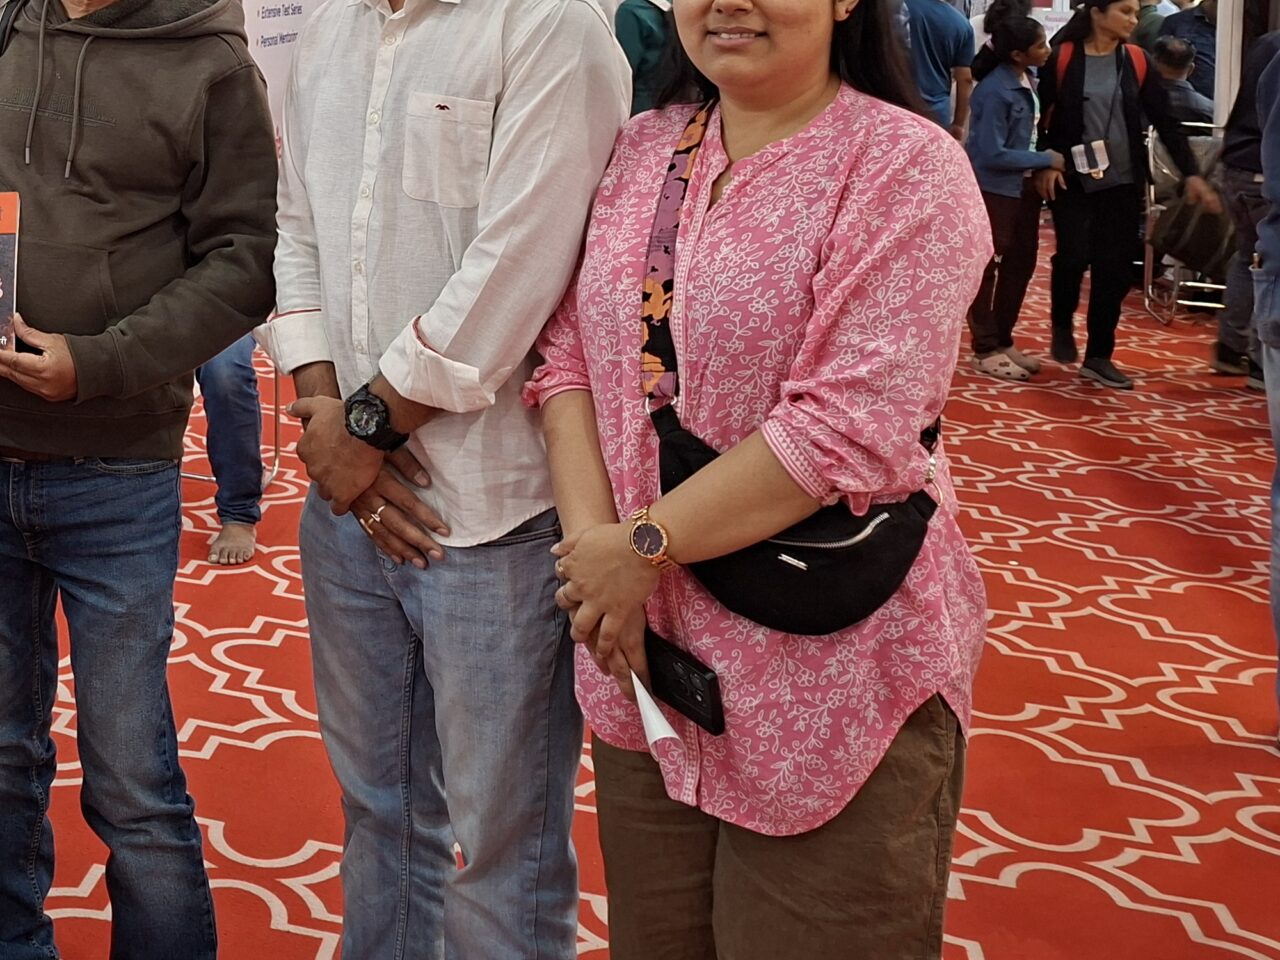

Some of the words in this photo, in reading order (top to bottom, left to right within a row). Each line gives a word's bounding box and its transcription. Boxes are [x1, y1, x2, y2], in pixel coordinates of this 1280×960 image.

[261, 6, 281, 19] Extensive
[282, 4, 290, 16] Test
[291, 3, 302, 15] Series
